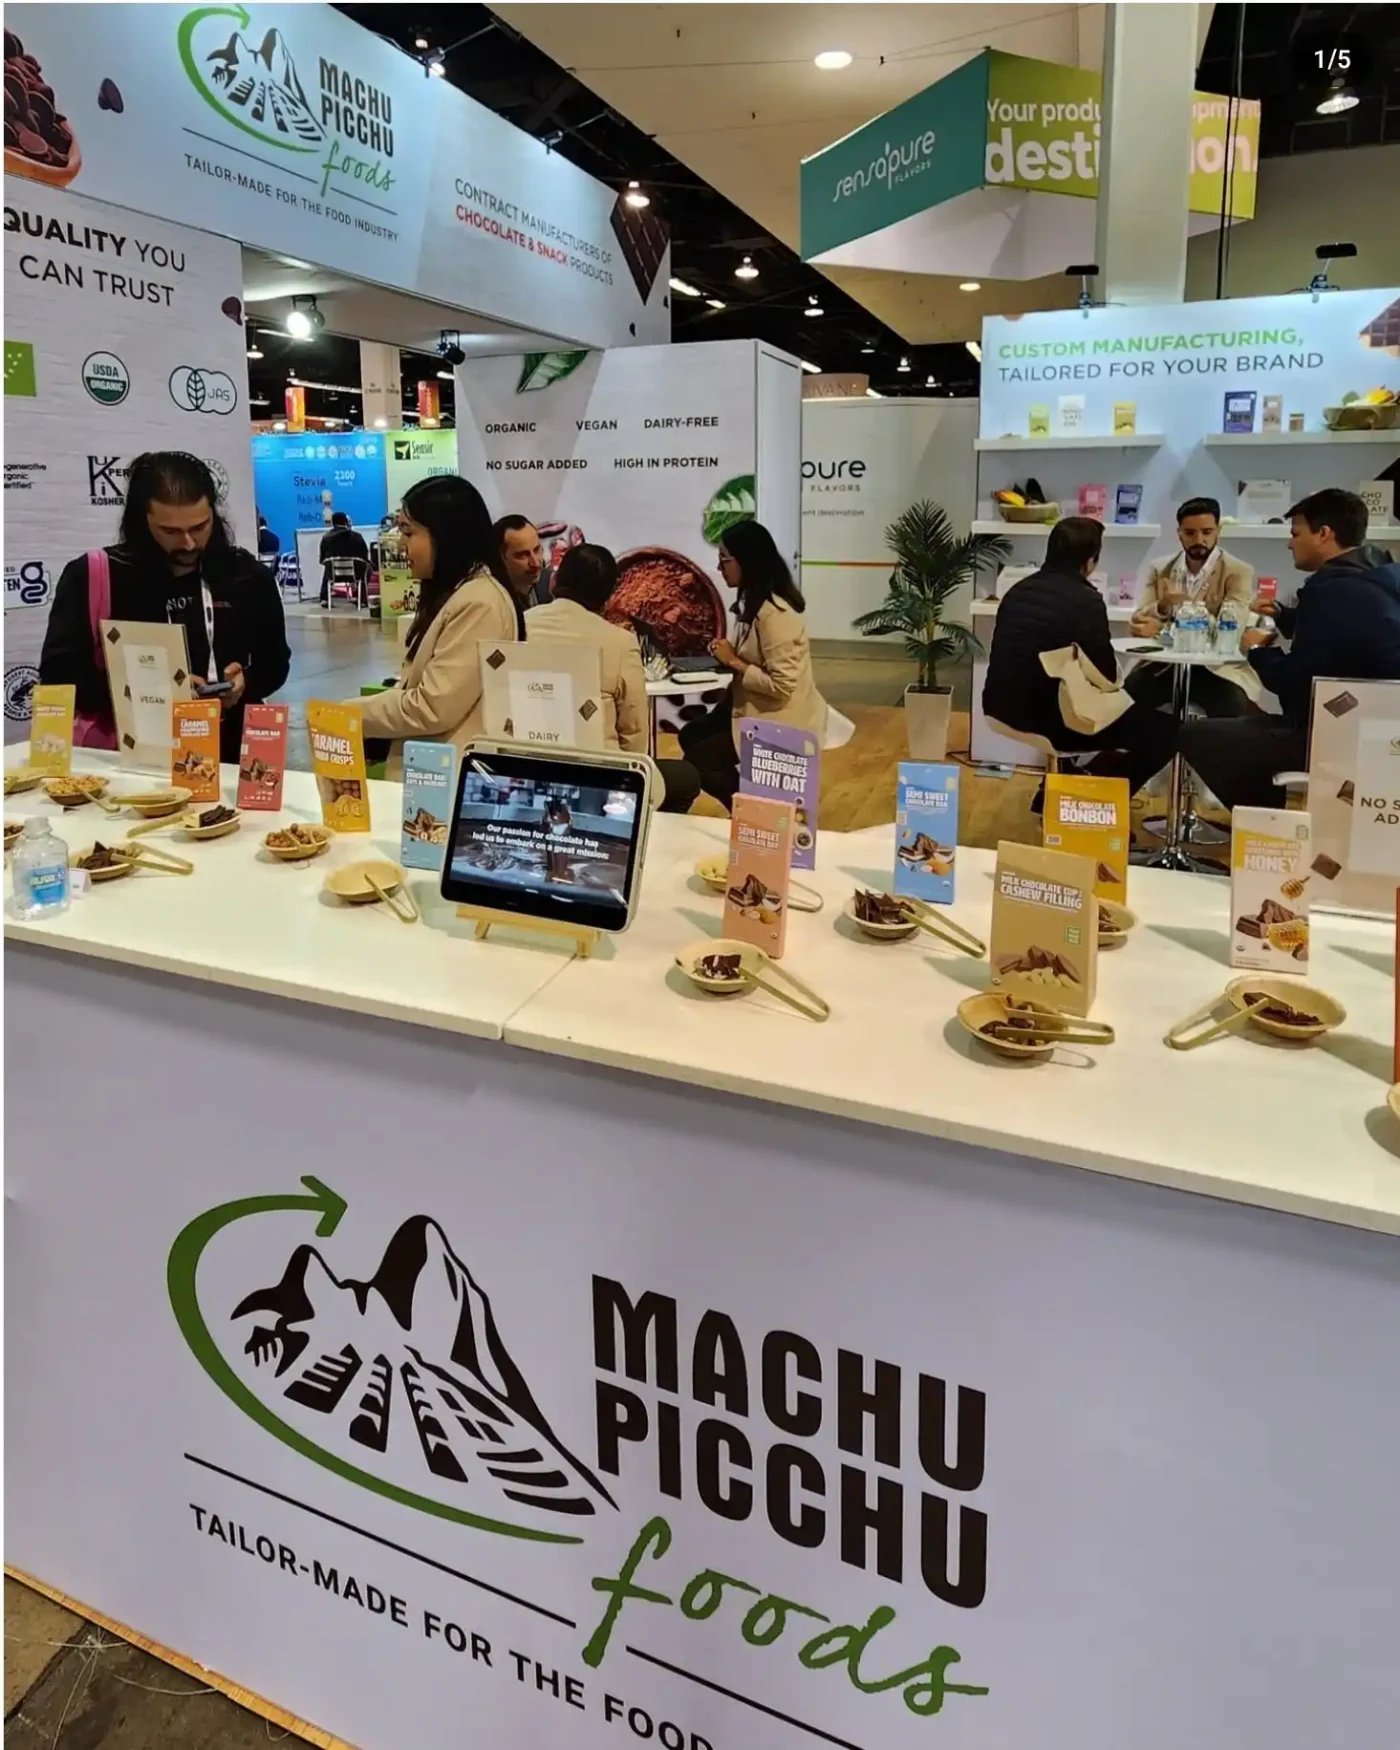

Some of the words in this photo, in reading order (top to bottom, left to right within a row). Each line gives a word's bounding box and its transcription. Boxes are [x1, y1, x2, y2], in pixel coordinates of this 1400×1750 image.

[319, 56, 392, 125] MACHU
[987, 98, 1037, 123] Your
[321, 92, 394, 158] PICCHU
[320, 140, 396, 198] foods
[184, 153, 272, 198] TAILOR-MADE
[276, 187, 299, 207] FOR
[301, 197, 322, 216] THE
[325, 206, 352, 226] FOOD
[355, 217, 399, 242] INDUSTRY
[455, 178, 519, 222] CONTRACT
[521, 211, 600, 261] MANUFACTURERS
[601, 250, 612, 265] OF
[4, 206, 126, 257] QUALITY
[135, 239, 186, 273] YOU
[455, 204, 526, 249] CHOCOLATE
[528, 237, 535, 251] &
[537, 241, 569, 266] SNACK
[570, 256, 614, 286] PRODUCTS
[19, 254, 84, 289] CAN
[93, 269, 175, 307] TRUST
[999, 341, 1086, 359] CUSTOM
[1092, 328, 1304, 355] MANUFACTURING,
[92, 363, 120, 378] USDA
[999, 363, 1102, 382] TAILORED
[1110, 360, 1155, 378] FOR
[1163, 357, 1228, 376] YOUR
[1237, 352, 1324, 372] BRAND
[90, 379, 125, 393] ORGANIC
[207, 388, 230, 402] JAS
[484, 421, 537, 434] ORGANIC
[575, 418, 619, 432] VEGAN
[643, 415, 720, 429] DAIRY-FREE
[486, 460, 502, 471] NO
[505, 459, 545, 471] SUGAR
[547, 458, 588, 470] ADDED
[614, 457, 644, 469] HIGH
[646, 457, 660, 468] IN
[663, 456, 719, 468] PROTEIN
[294, 475, 327, 487] Stevia
[810, 484, 862, 493] FLAVORS
[91, 497, 125, 506] KOSHER
[139, 695, 166, 705] VEGAN
[528, 731, 560, 742] DAIRY
[751, 756, 808, 778] BLUEBERRIES
[753, 747, 773, 759] WHITE
[773, 751, 808, 766] CHOCOLATE
[751, 767, 781, 788] WITH
[782, 775, 807, 793] OAT
[905, 789, 923, 800] SEMI
[924, 791, 948, 801] SWEET
[1360, 796, 1387, 810] NO
[1060, 808, 1117, 825] BONBON
[472, 831, 485, 840] led
[485, 834, 495, 842] us
[495, 835, 504, 843] to
[505, 836, 535, 849] embark
[535, 842, 546, 850] on
[553, 845, 575, 855] great
[487, 823, 502, 832] Our
[502, 826, 531, 838] passion
[532, 830, 544, 839] for
[545, 832, 584, 846] chocolate
[585, 838, 599, 849] has
[1244, 853, 1299, 874] HONEY
[1000, 883, 1042, 901] CASHEW
[1043, 891, 1082, 910] FILLING
[1001, 875, 1020, 887] MILK
[1020, 878, 1063, 894] CHOCOLATE
[592, 1274, 987, 1492] MACHU
[595, 1379, 989, 1609] PICCHU
[189, 1503, 409, 1628] TAILOR-MADE
[423, 1610, 493, 1668] FOR
[509, 1649, 587, 1711] THE
[581, 1516, 990, 1716] foods
